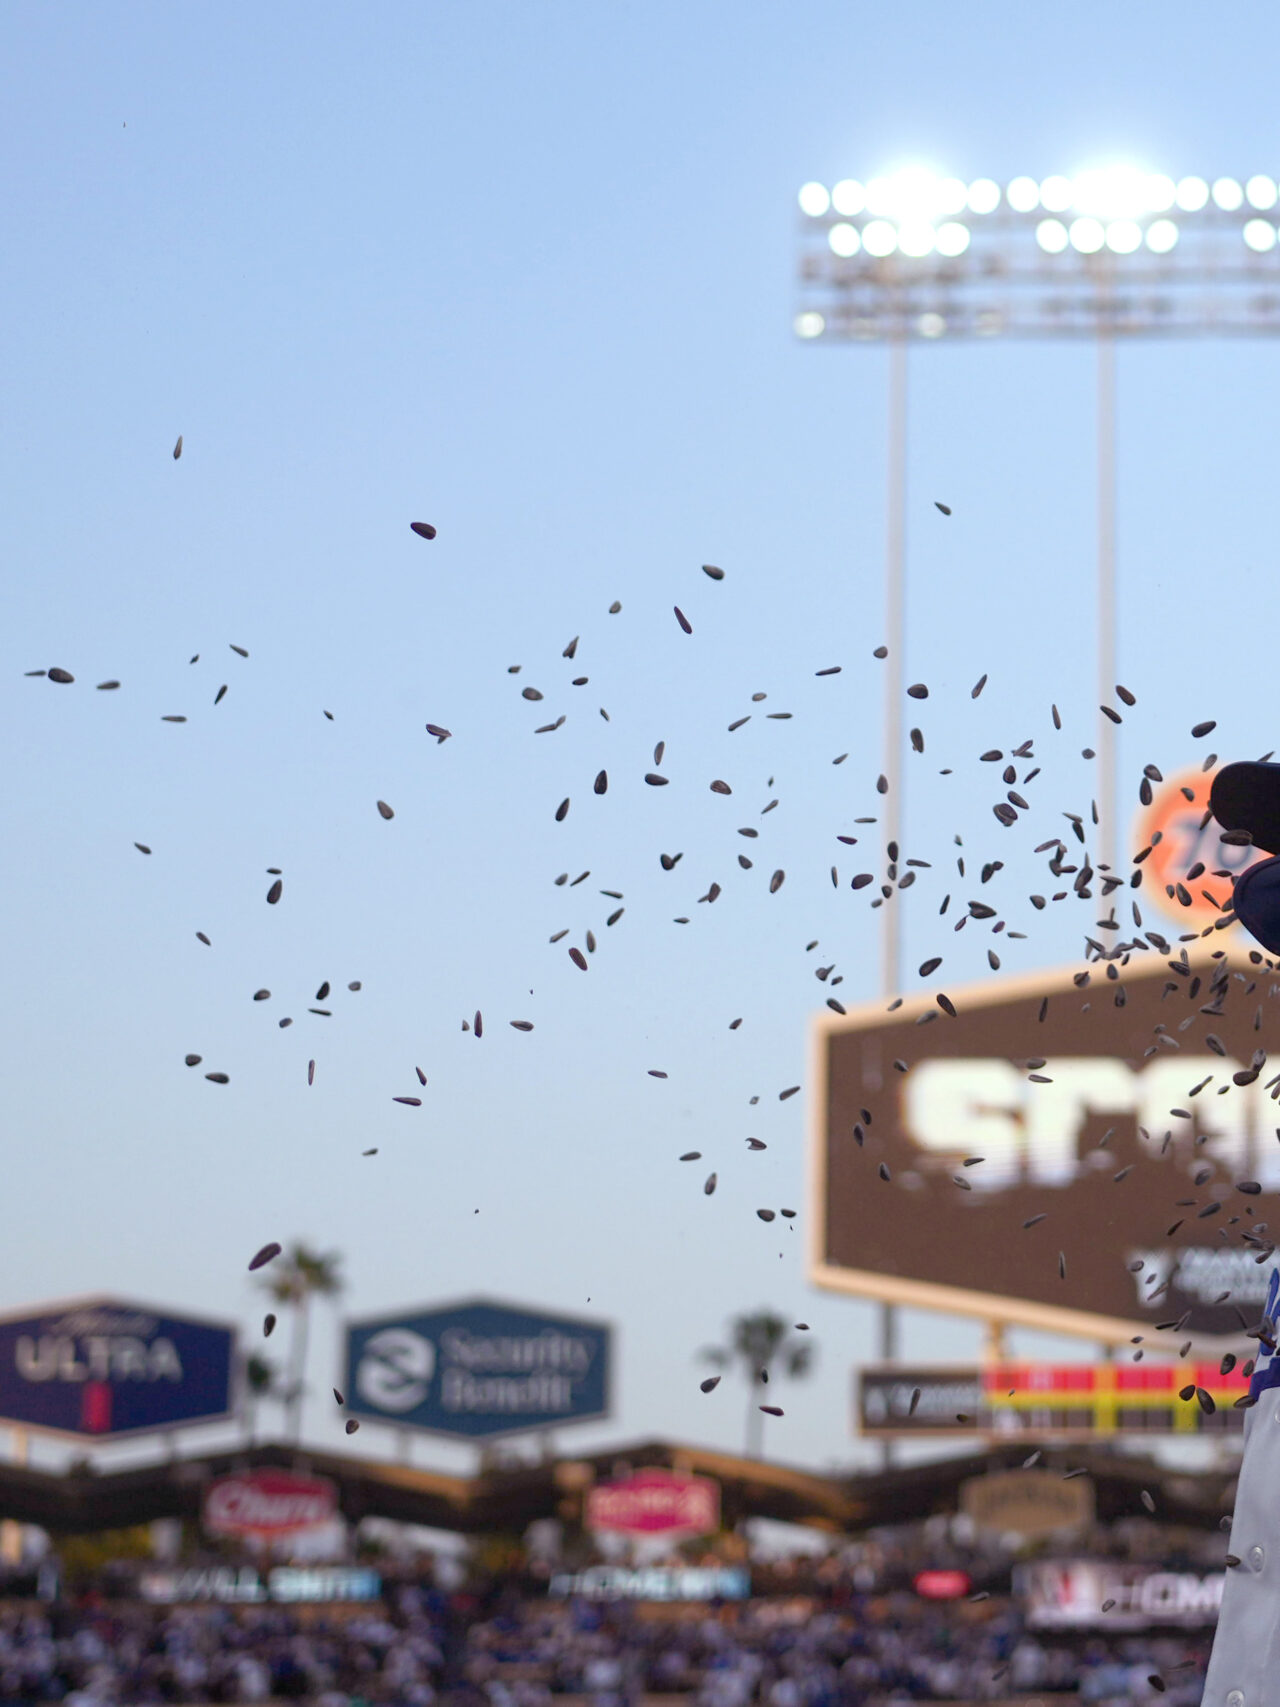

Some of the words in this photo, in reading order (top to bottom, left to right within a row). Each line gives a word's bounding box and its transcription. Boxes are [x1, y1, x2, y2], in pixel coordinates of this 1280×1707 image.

[18, 1336, 182, 1380] ULTRA
[443, 1330, 594, 1378] Security
[444, 1369, 572, 1411] Benefit
